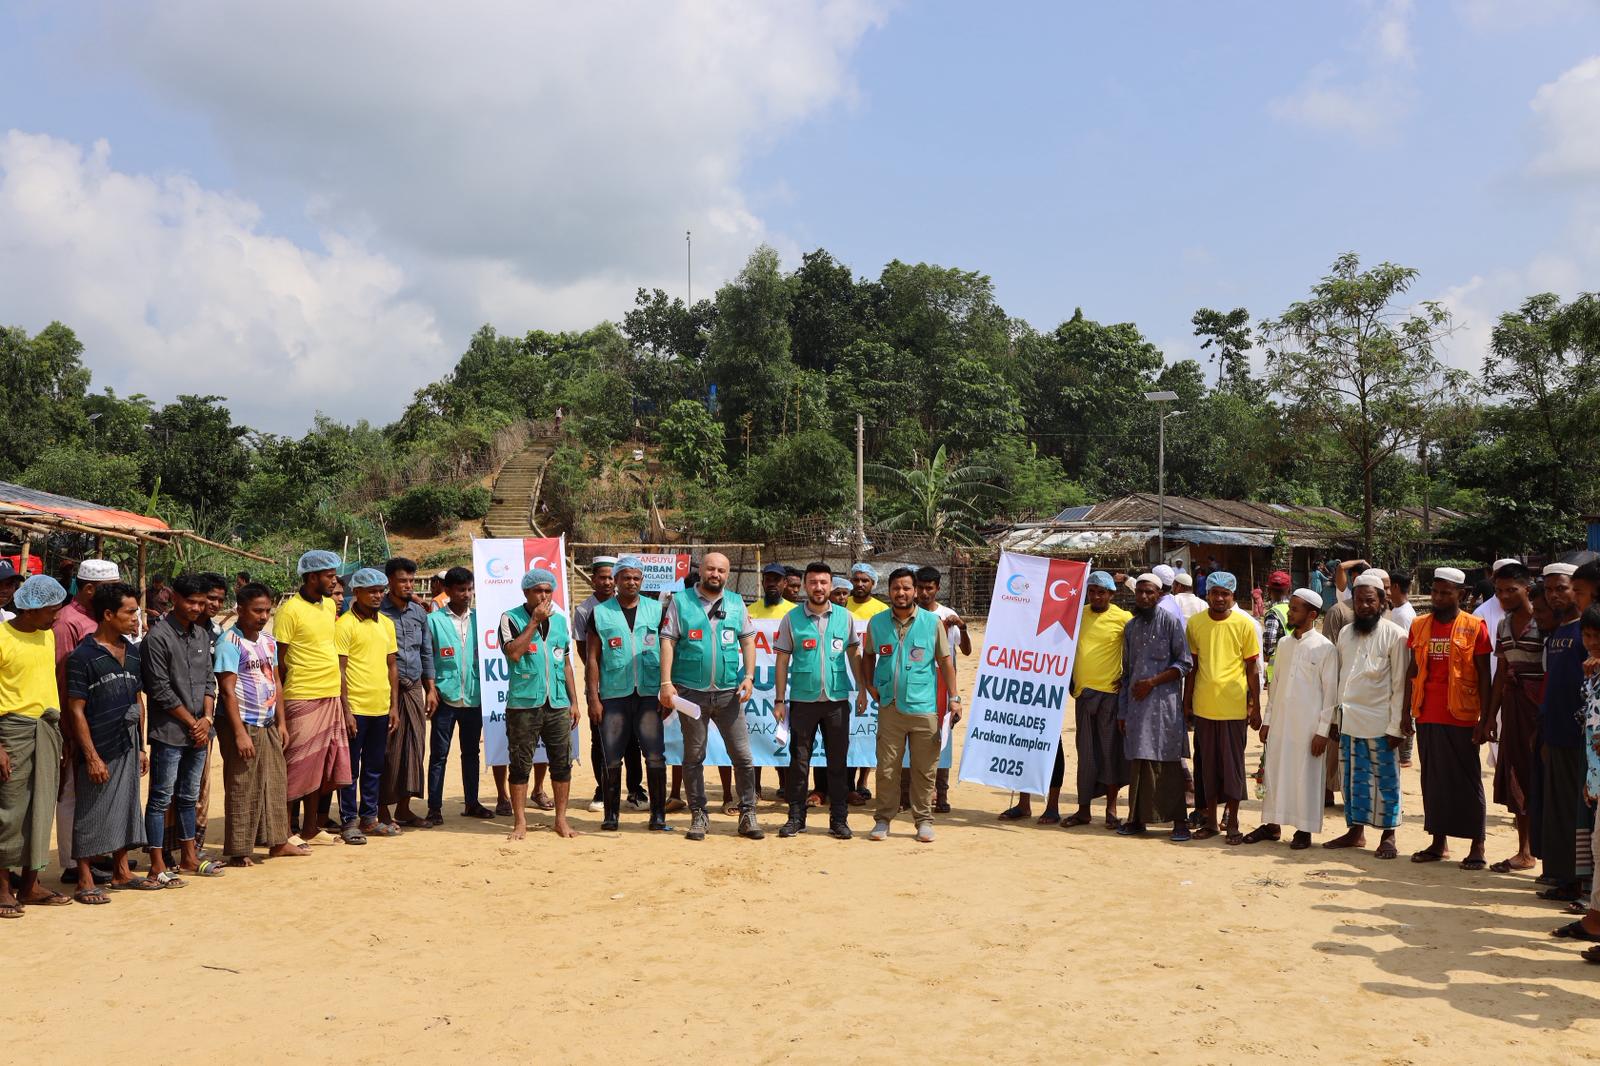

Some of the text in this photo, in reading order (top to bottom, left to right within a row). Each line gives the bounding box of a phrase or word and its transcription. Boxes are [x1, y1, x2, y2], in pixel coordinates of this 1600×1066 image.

[637, 556, 674, 564] ANSUYU
[1001, 594, 1031, 603] CANSUYU
[986, 645, 1068, 677] CANSUYU
[977, 674, 1065, 710] KURBAN
[983, 708, 1047, 735] BANGLADEŞ
[970, 726, 1052, 752] Arakan Kampları
[989, 756, 1024, 777] 2025
